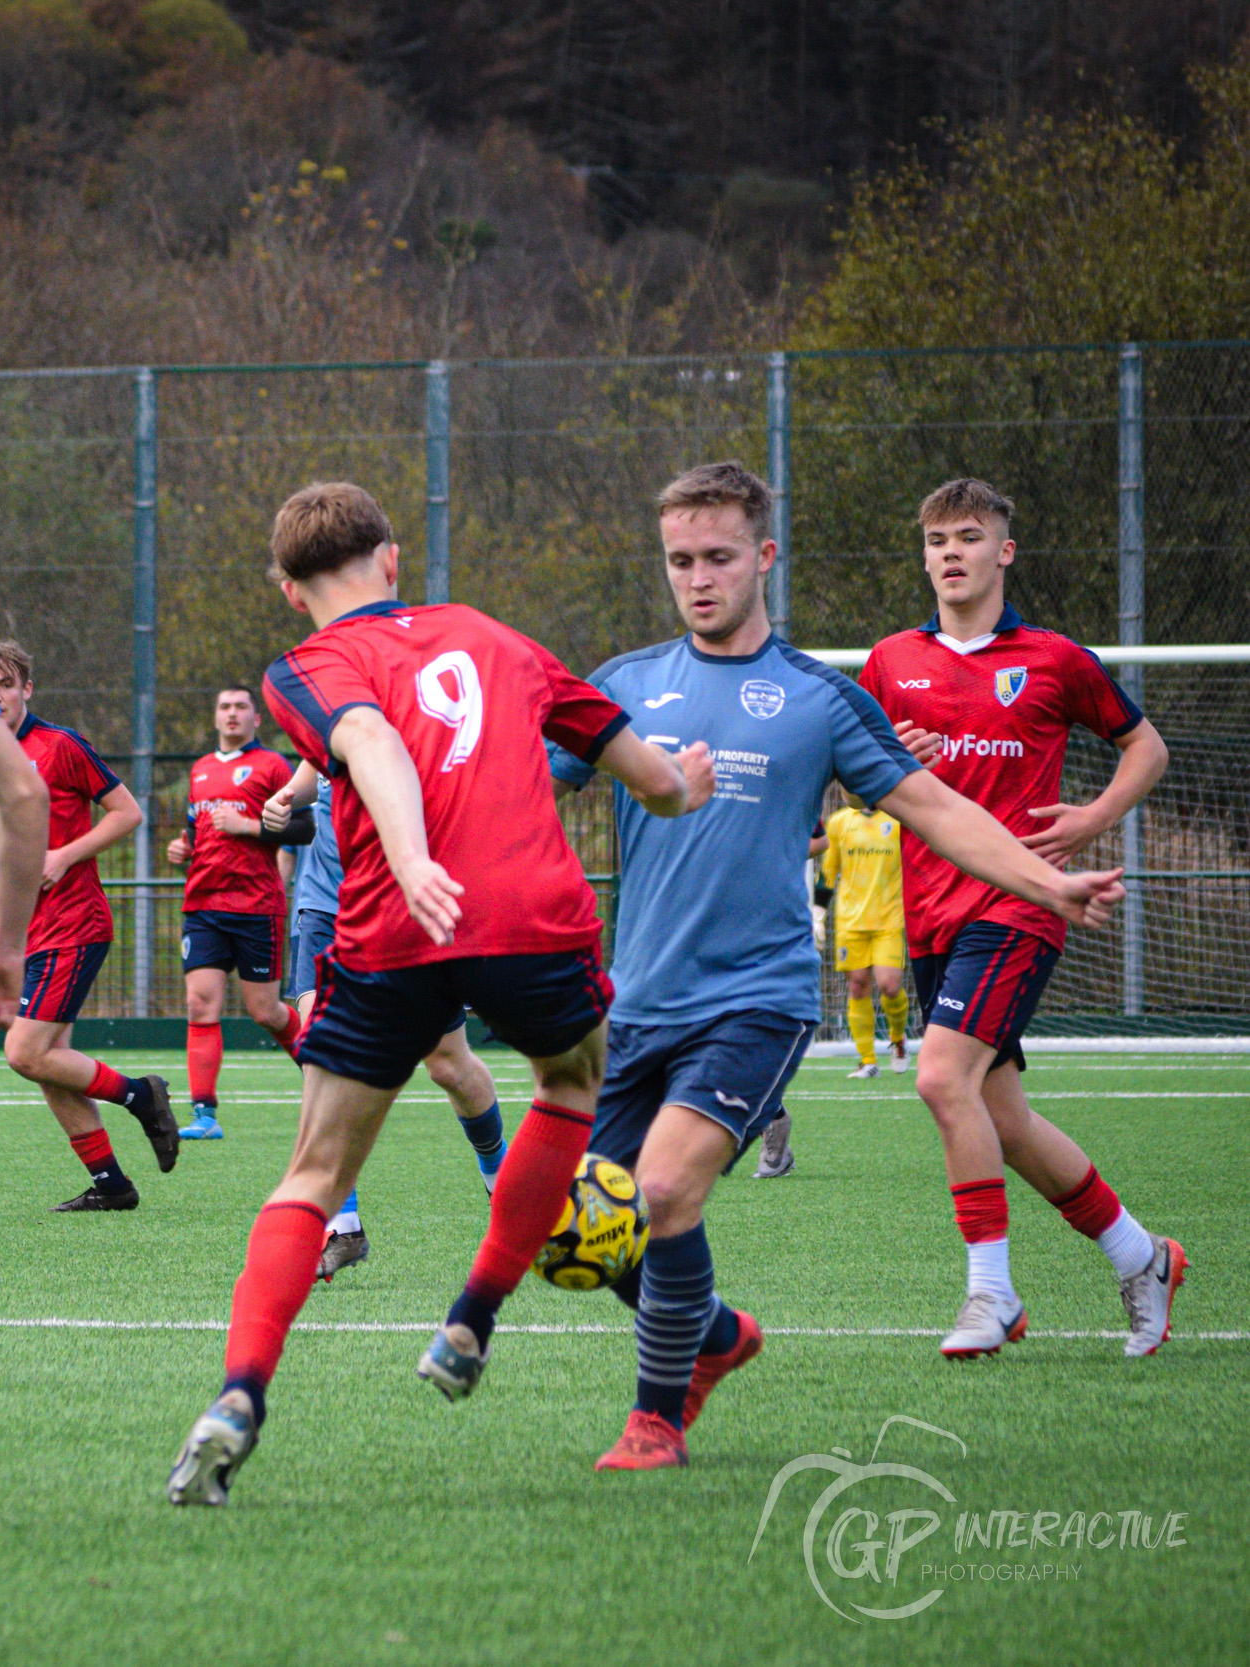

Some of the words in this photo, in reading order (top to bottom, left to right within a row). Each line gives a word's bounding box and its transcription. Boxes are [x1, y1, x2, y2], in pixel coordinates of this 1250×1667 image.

[897, 679, 931, 689] VX3
[415, 650, 483, 772] 9
[718, 750, 770, 766] PROPERTY
[712, 762, 768, 777] INTENANCE
[937, 996, 965, 1011] VX3
